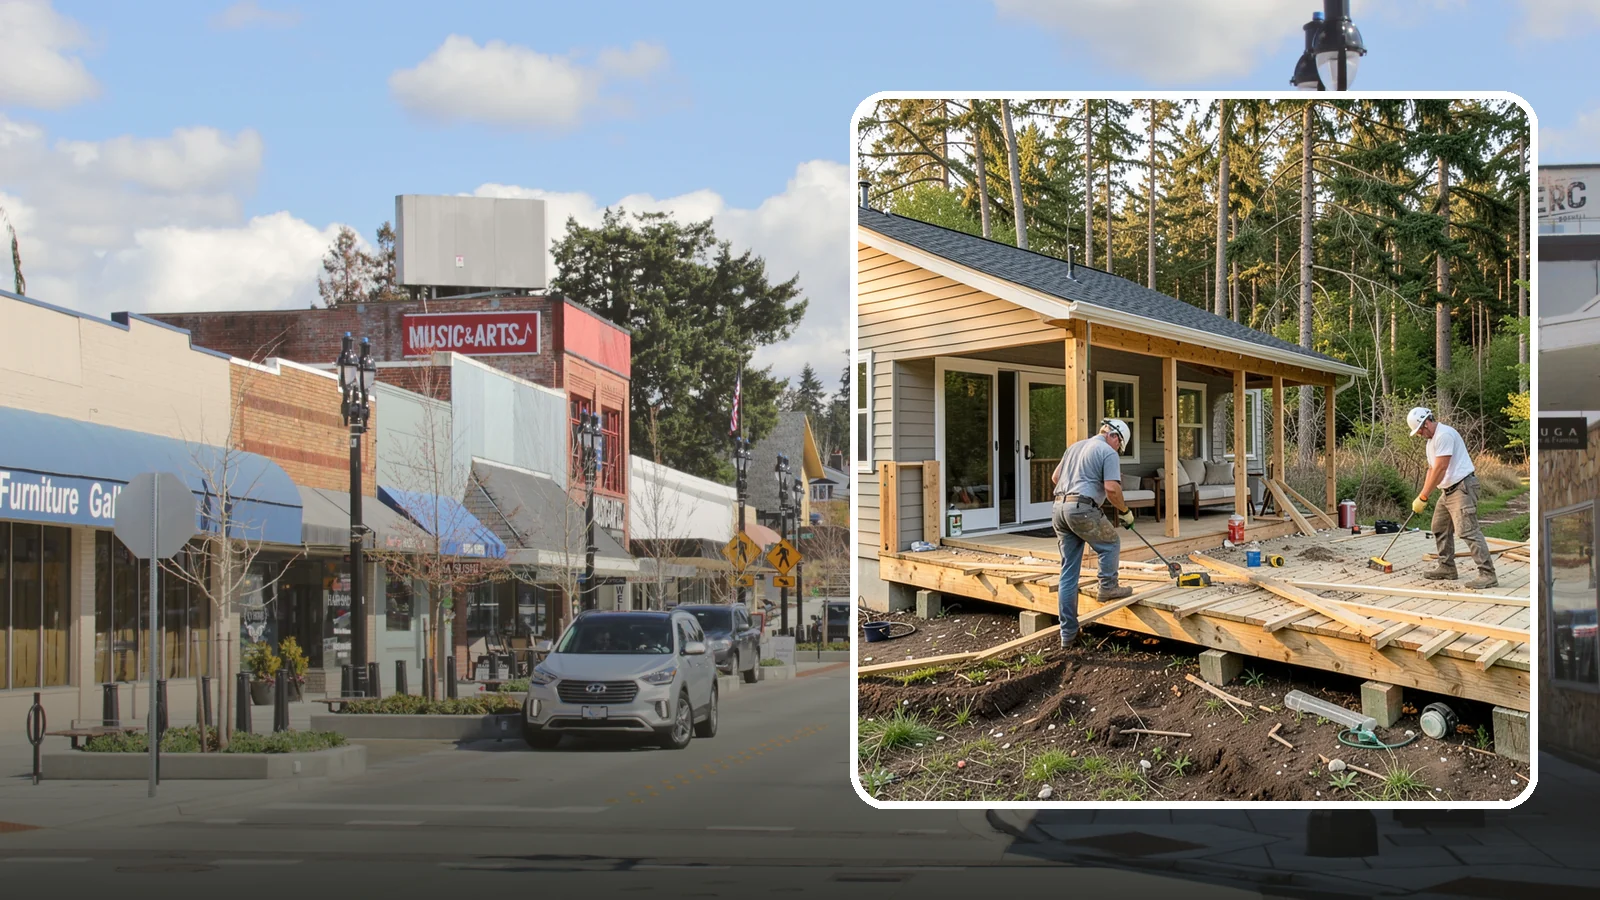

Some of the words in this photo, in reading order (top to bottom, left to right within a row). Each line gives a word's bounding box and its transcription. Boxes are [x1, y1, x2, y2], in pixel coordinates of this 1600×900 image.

[0, 471, 79, 516] Furniture
[89, 482, 122, 520] Gal
[452, 563, 480, 575] SUSHI
